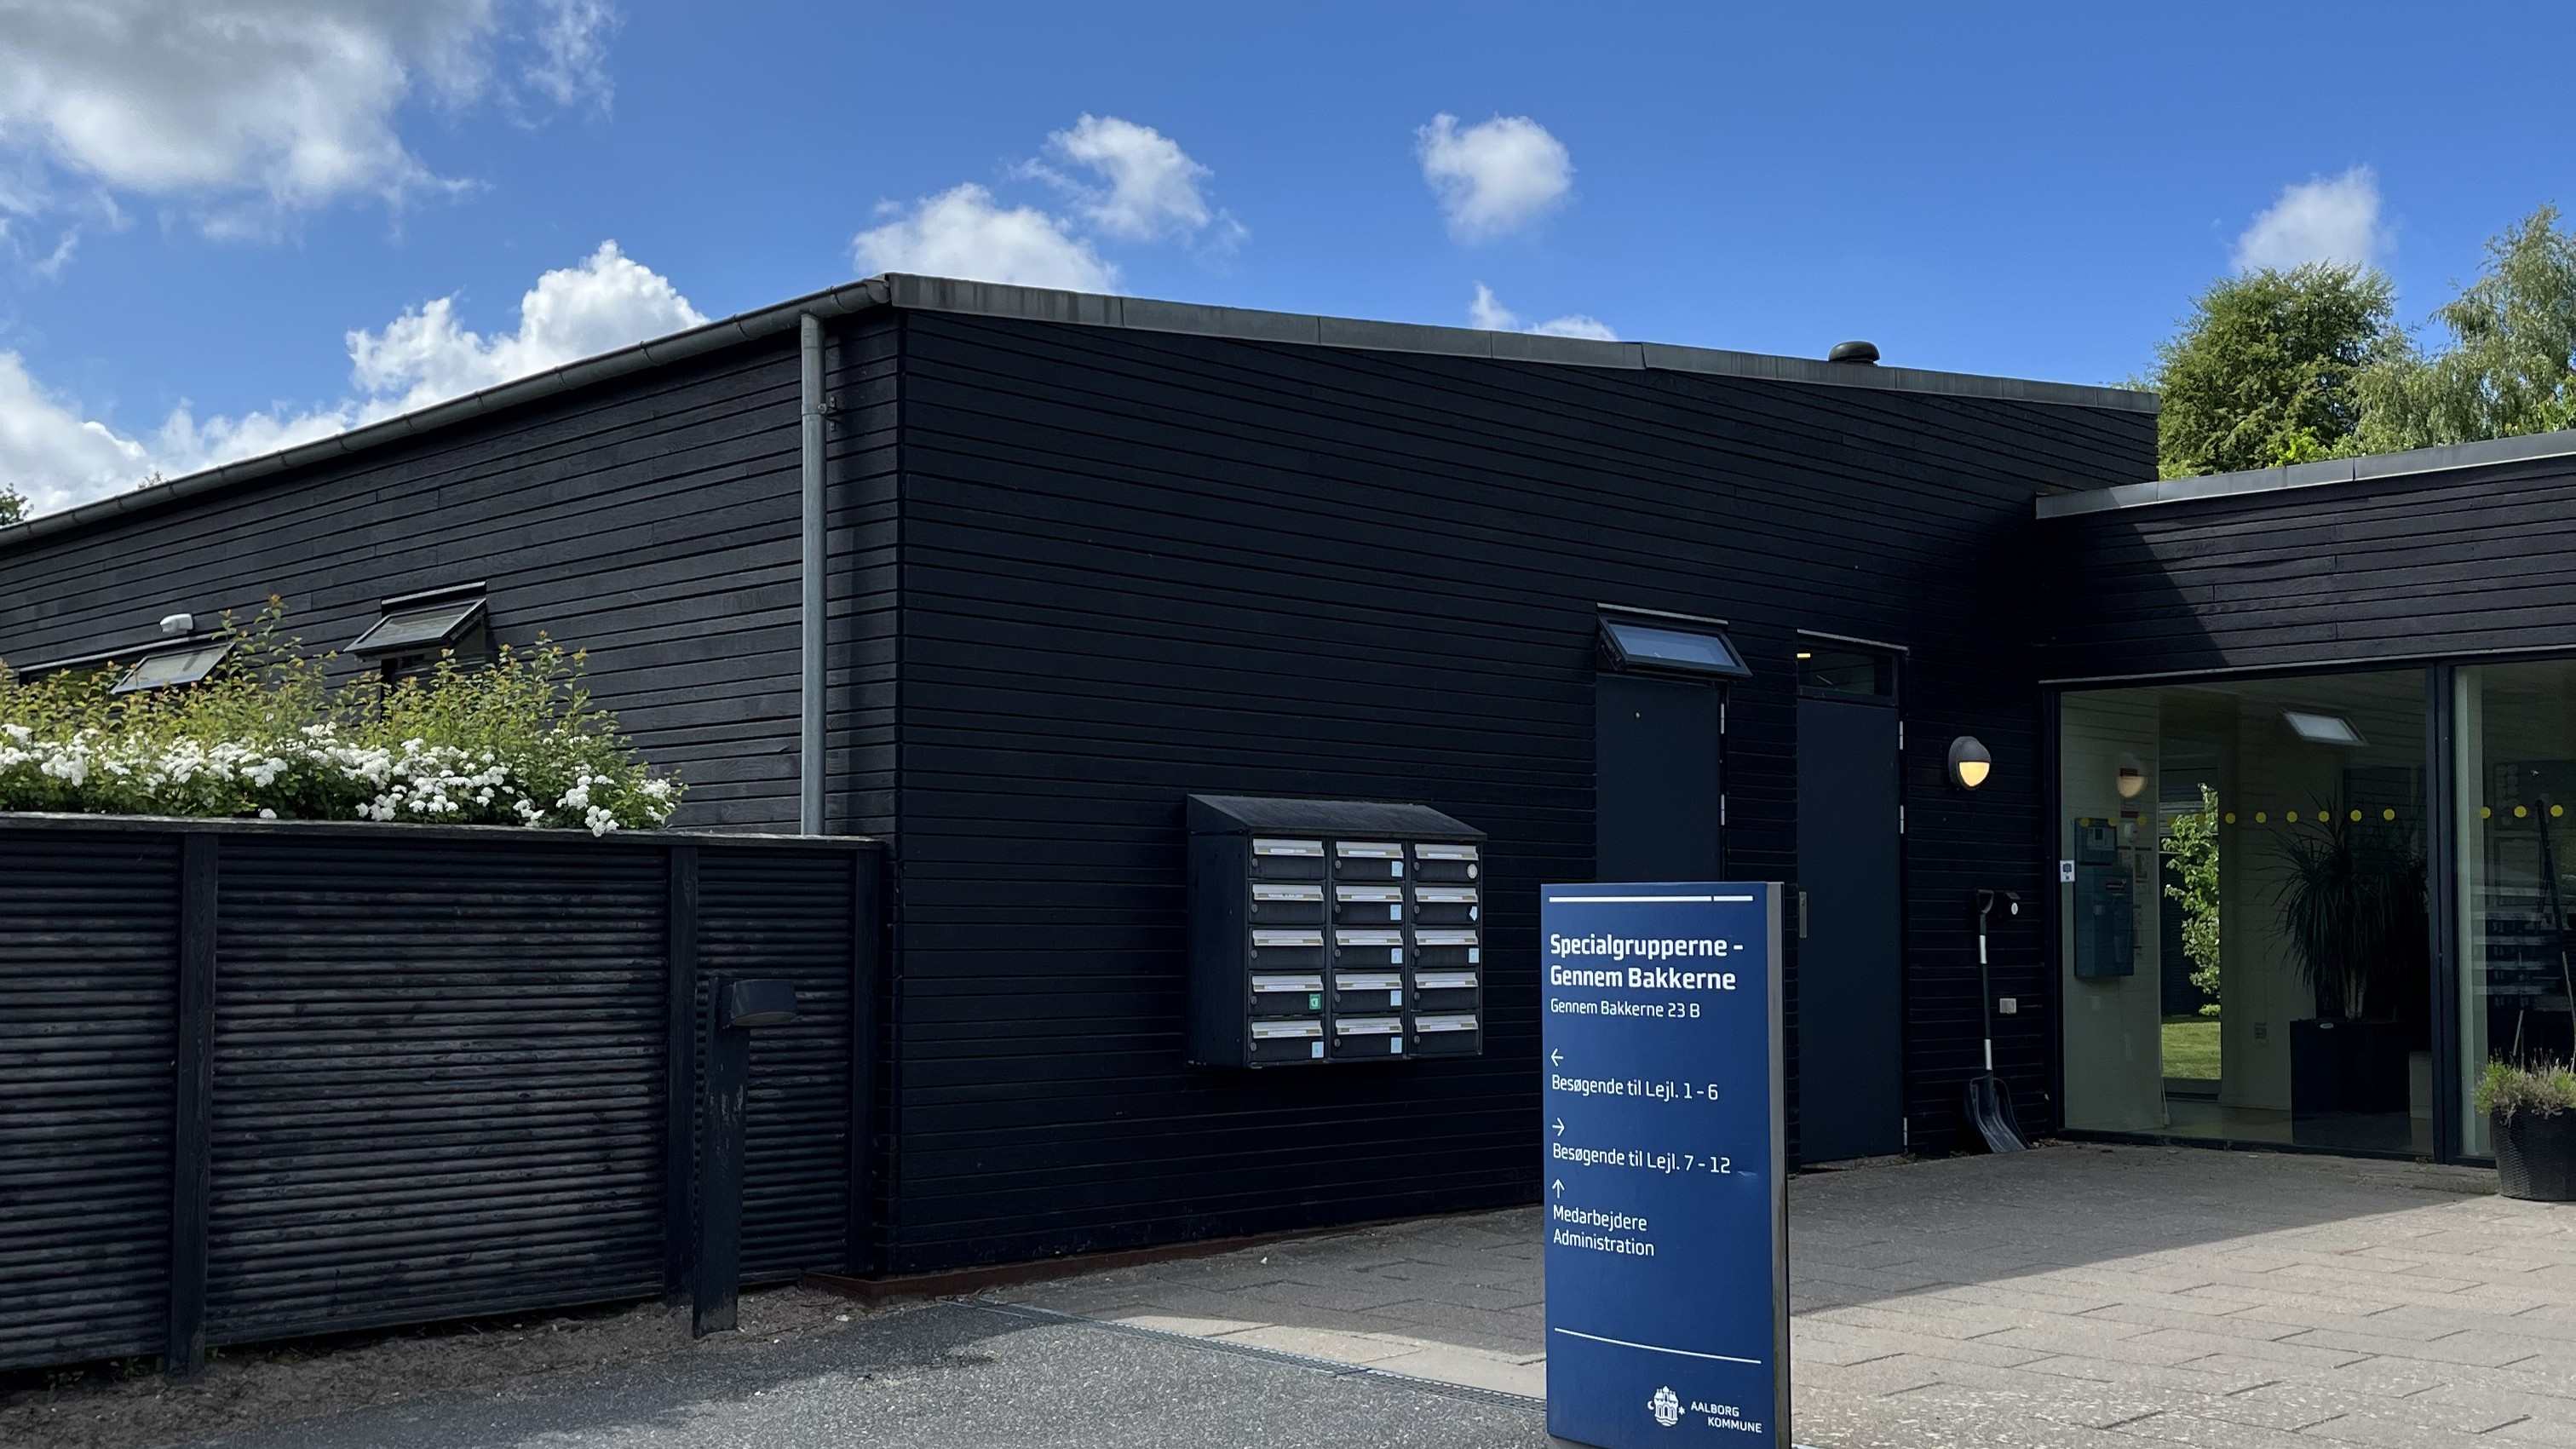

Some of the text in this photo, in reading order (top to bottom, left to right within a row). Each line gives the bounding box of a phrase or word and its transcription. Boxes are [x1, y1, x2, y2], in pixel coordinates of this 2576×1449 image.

[1550, 934, 1727, 960] Specialgrupperne
[1551, 965, 1736, 990] Gennem Bakkerne
[1551, 998, 1699, 1018] Gennem Bakkerne 23 B
[1552, 1074, 1623, 1095] Besøgende
[1627, 1080, 1641, 1095] til
[1646, 1081, 1678, 1101] Lejl.
[1684, 1083, 1693, 1099] 1
[1708, 1084, 1718, 1100] 6
[1553, 1143, 1624, 1166] Besøgende
[1629, 1151, 1642, 1166] til
[1647, 1153, 1680, 1173] Lejl.
[1684, 1155, 1693, 1172] 7
[1711, 1157, 1730, 1174] 12
[1553, 1205, 1647, 1232] Medarbejdere
[1553, 1228, 1654, 1256] Administration
[1691, 1401, 1739, 1417] AALBORG
[1708, 1417, 1762, 1434] KOMMUNE
